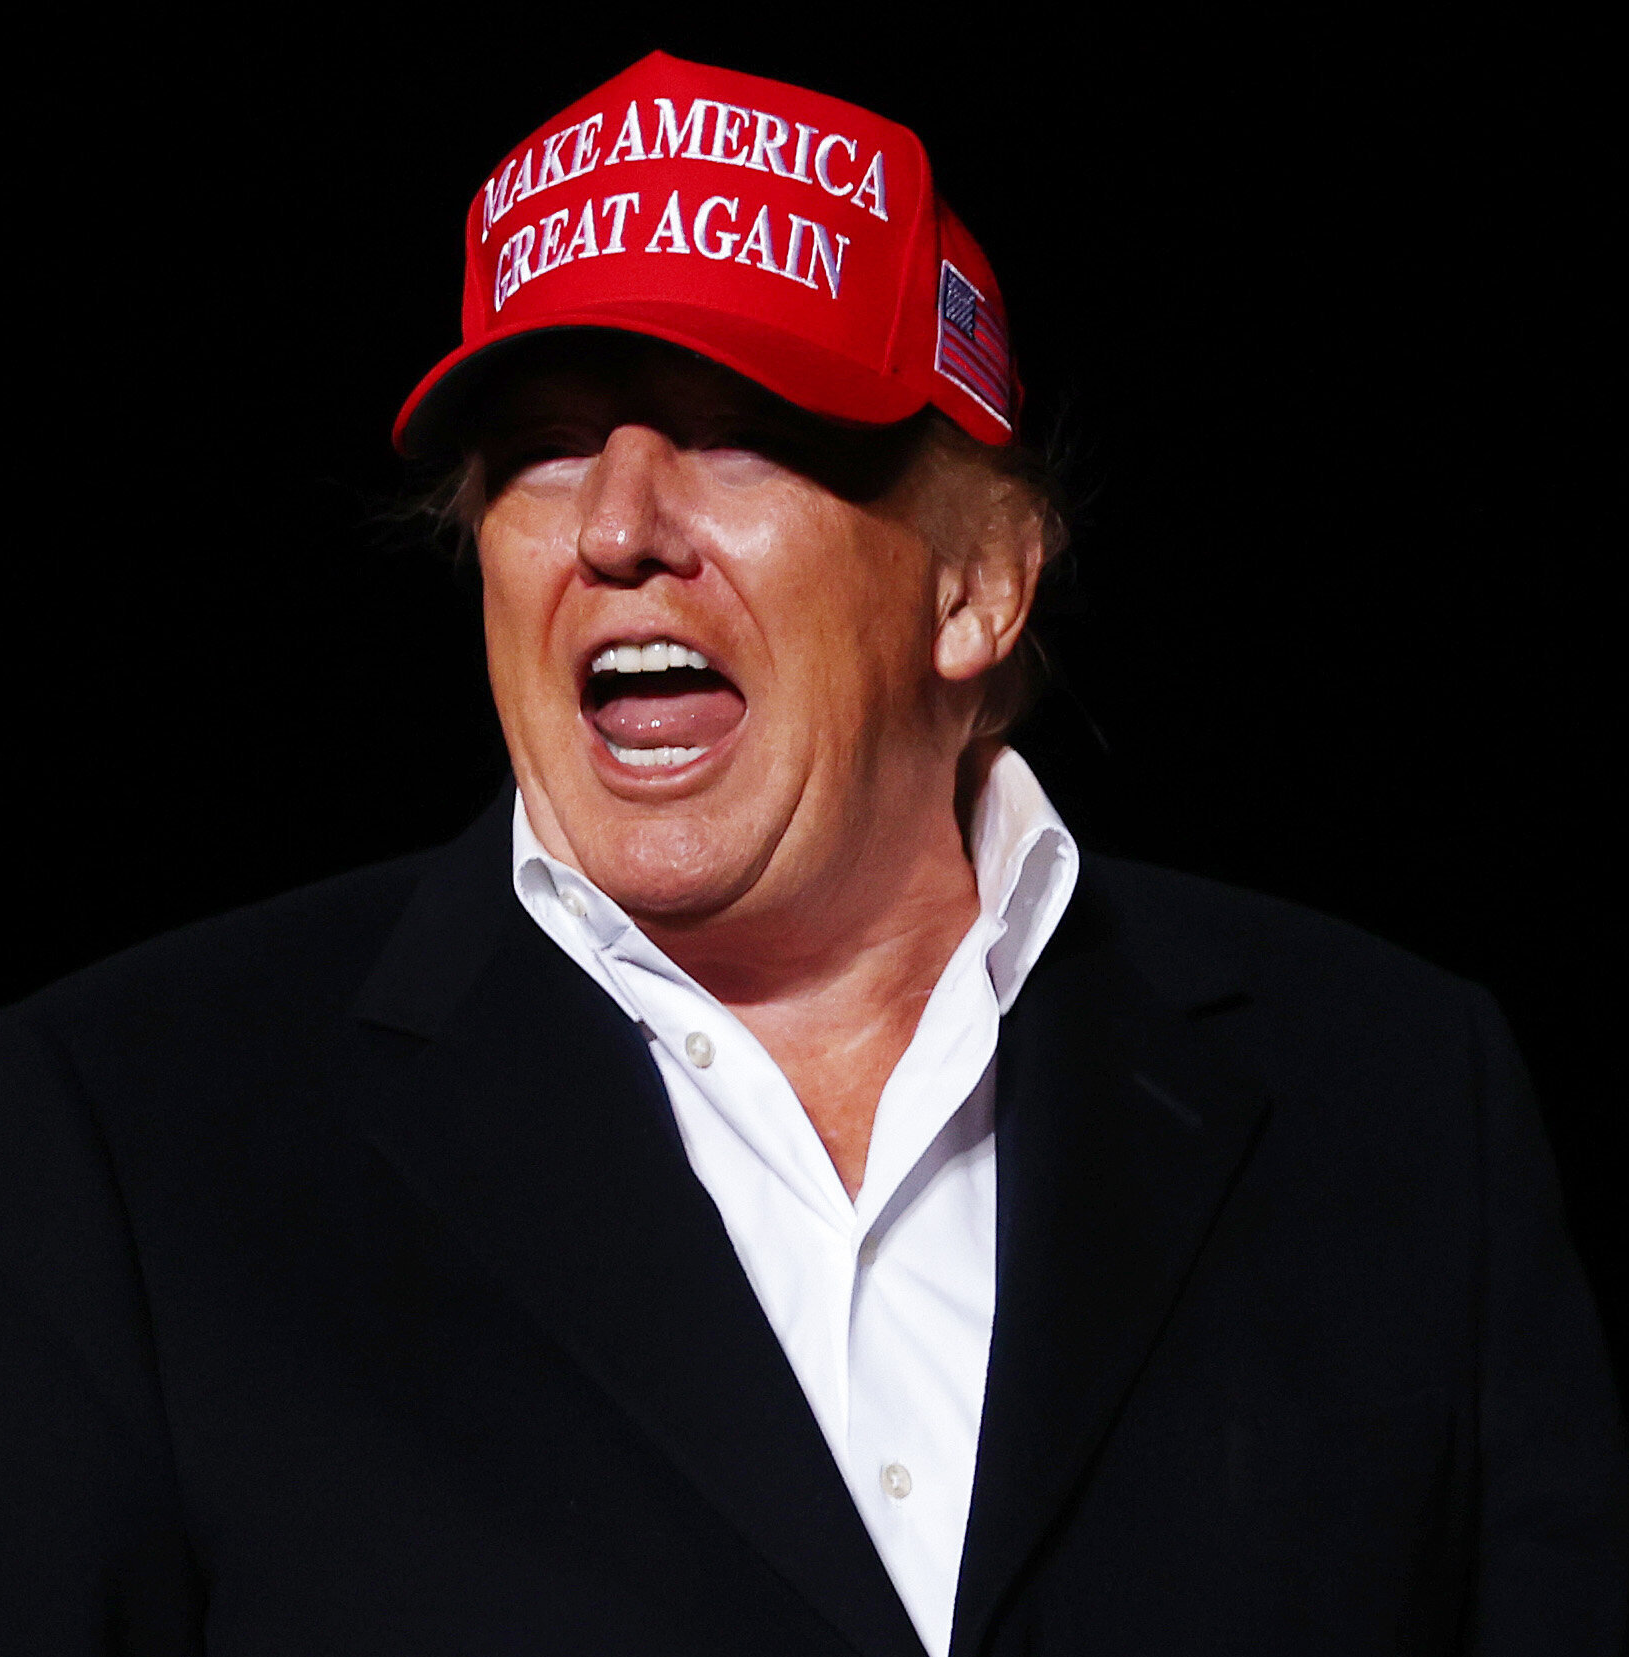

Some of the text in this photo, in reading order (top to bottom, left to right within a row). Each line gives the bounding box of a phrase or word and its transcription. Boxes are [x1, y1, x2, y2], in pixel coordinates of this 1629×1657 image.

[481, 98, 889, 243] MAKE AMERICA
[494, 190, 851, 313] GREAT AGAIN
